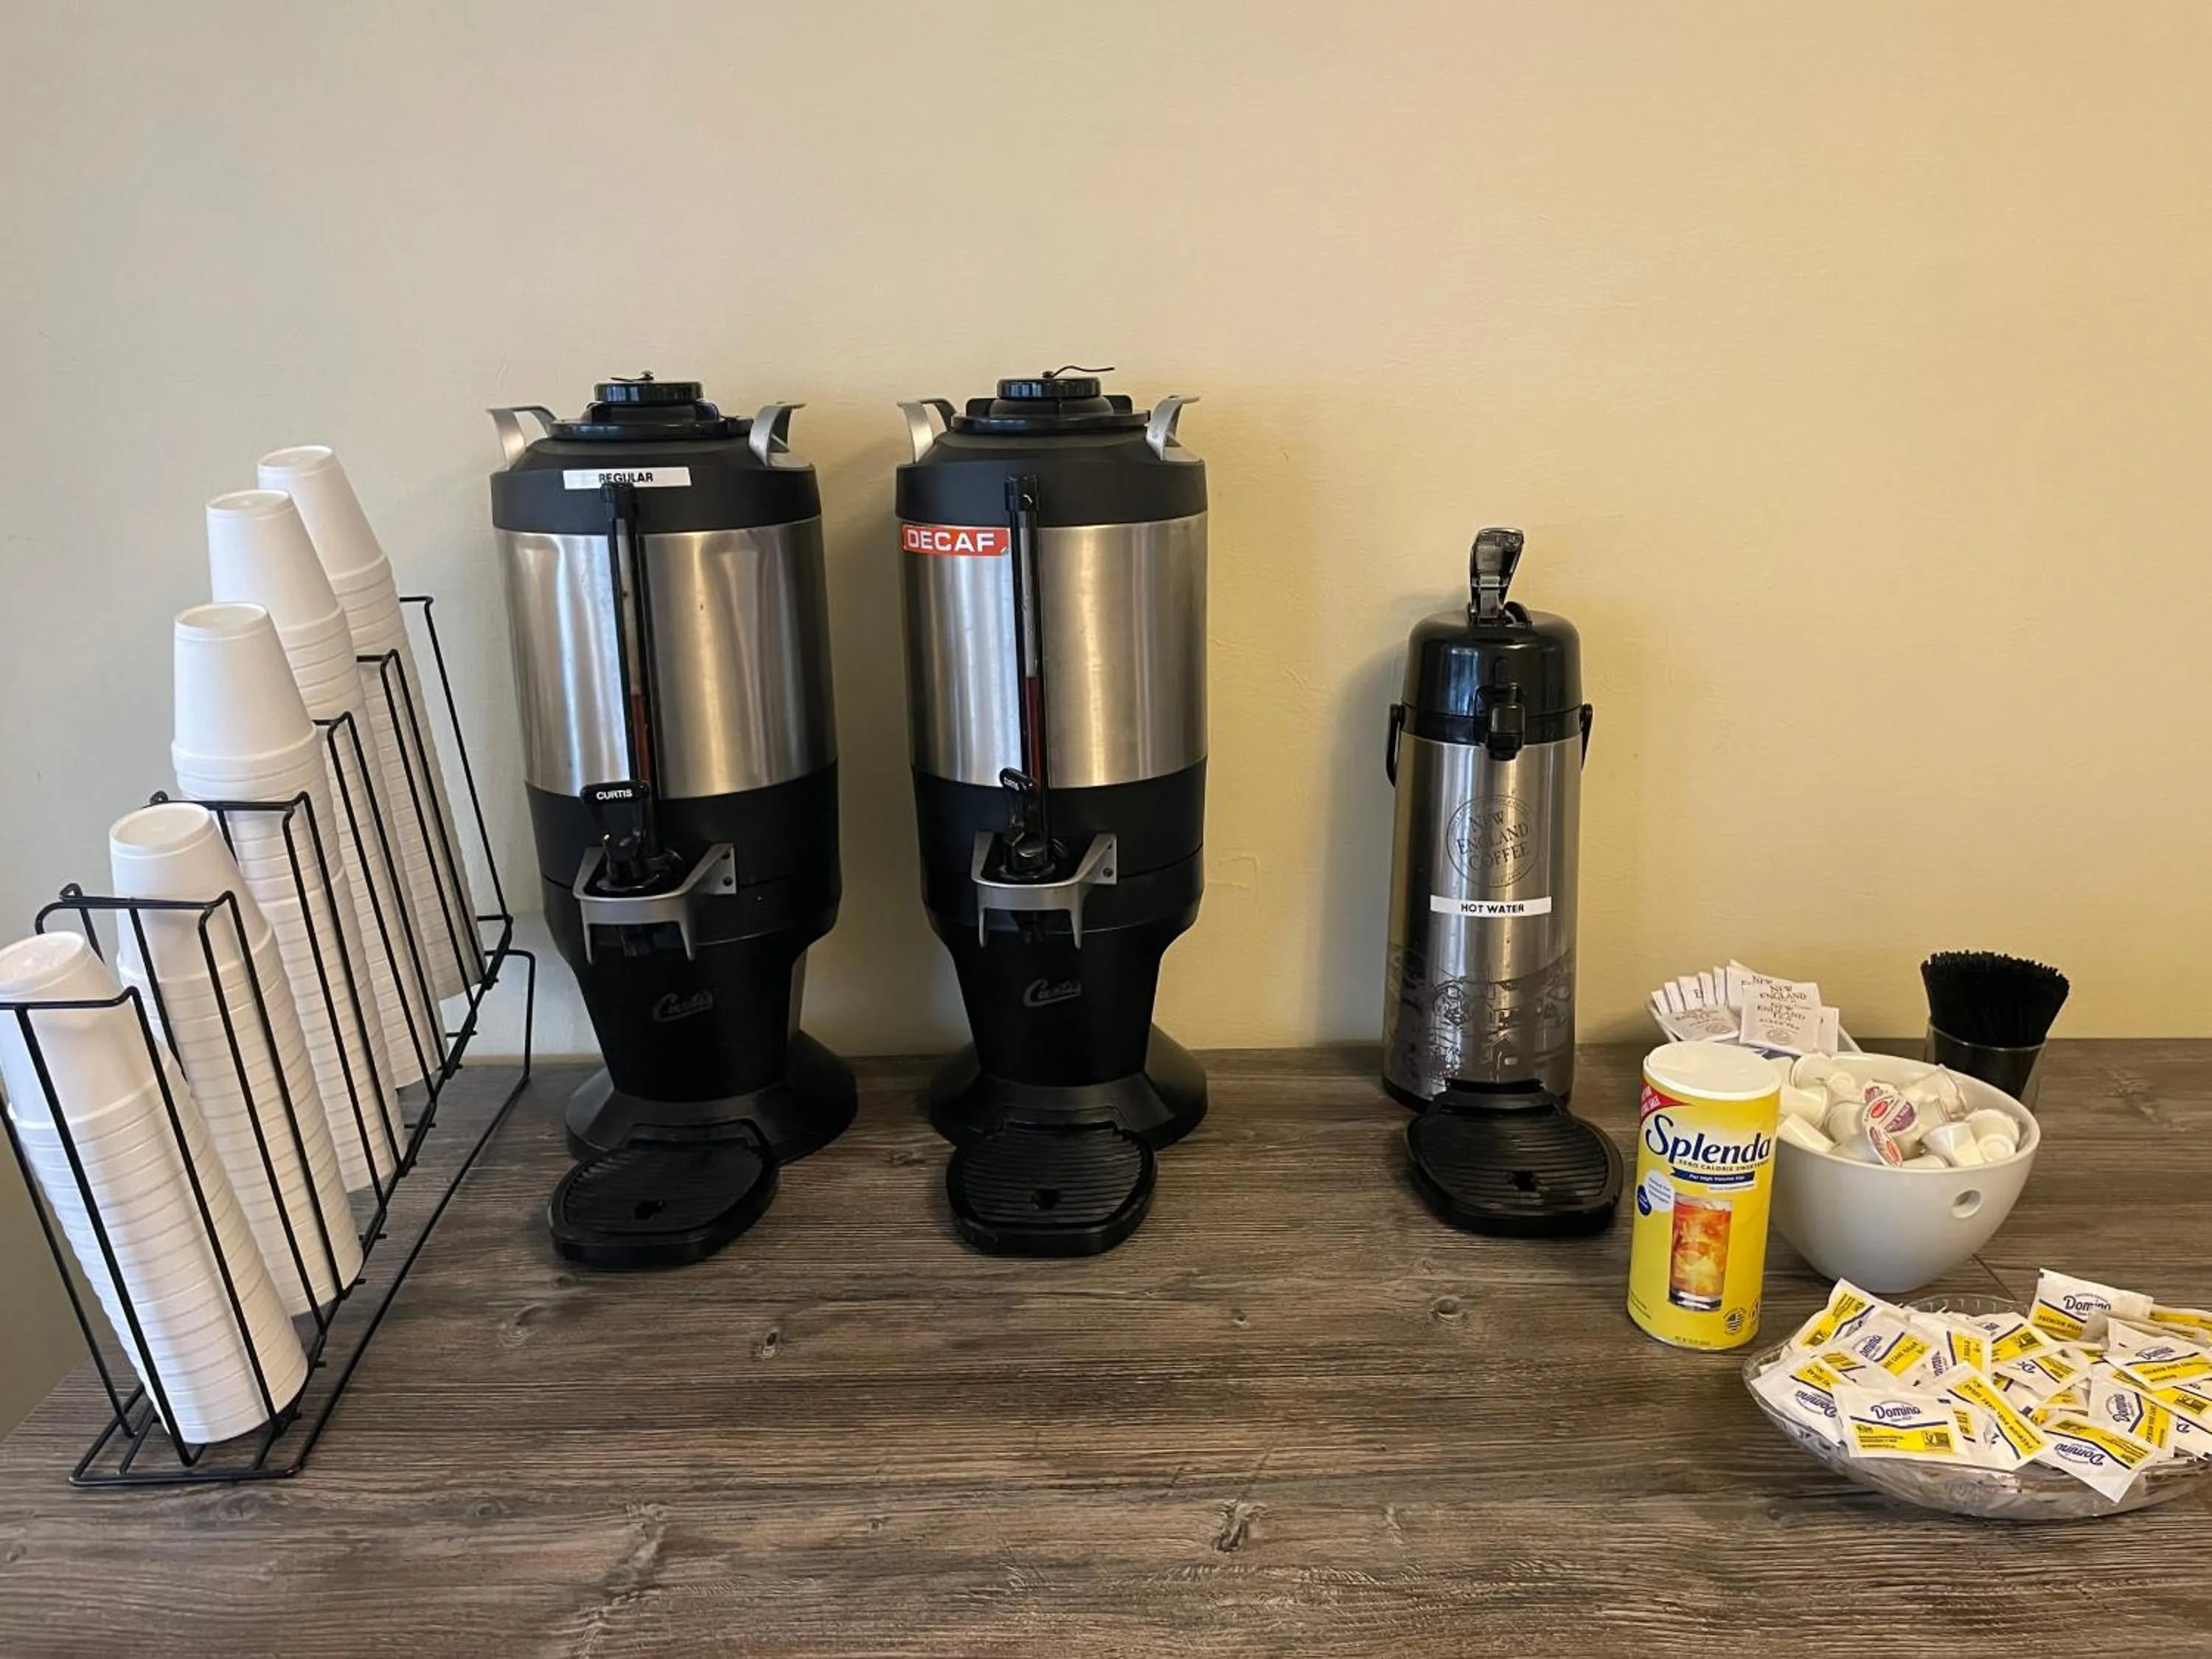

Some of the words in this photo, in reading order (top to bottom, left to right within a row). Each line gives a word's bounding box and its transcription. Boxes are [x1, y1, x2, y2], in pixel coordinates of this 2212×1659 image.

[598, 473, 653, 484] REGULAR
[907, 529, 995, 552] DECAF
[596, 788, 633, 800] CURTIS
[1457, 823, 1528, 855] ENGLAND
[1468, 842, 1530, 872] COFFEE
[1461, 903, 1484, 914] HOT
[1486, 903, 1524, 914] WATER
[1645, 1114, 1771, 1164] Splenda
[1870, 1404, 1922, 1420] Domino
[2054, 1443, 2104, 1467] Domino
